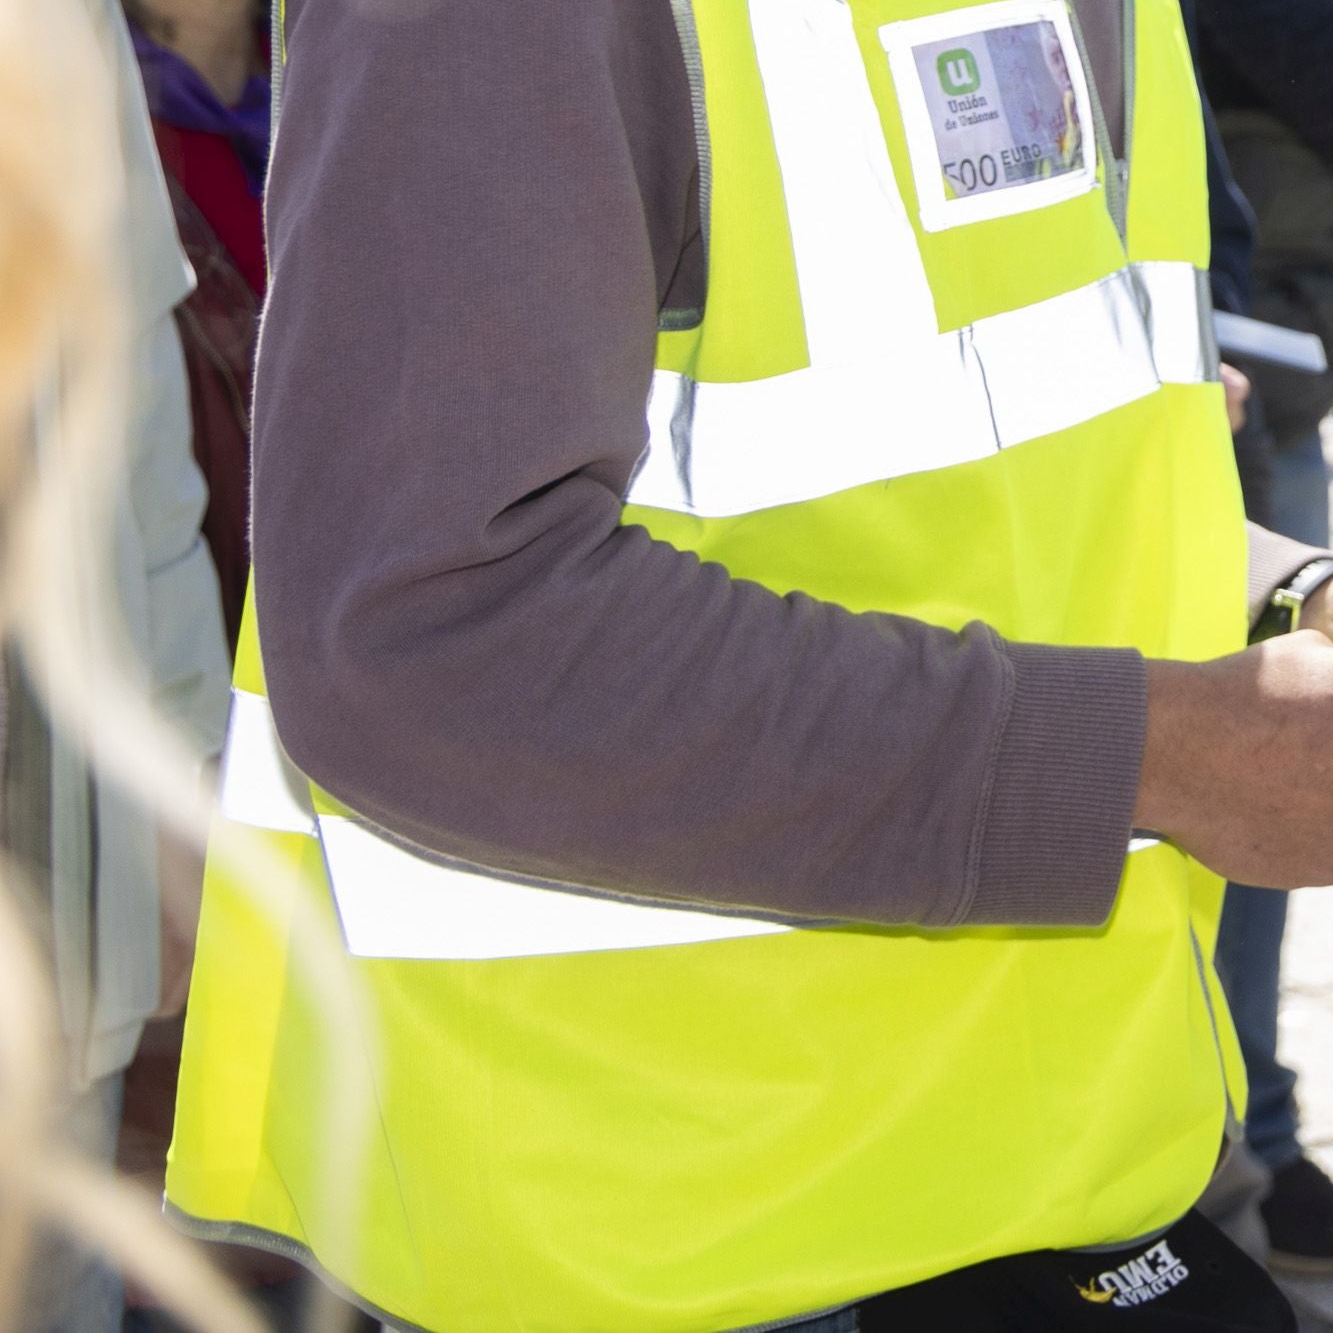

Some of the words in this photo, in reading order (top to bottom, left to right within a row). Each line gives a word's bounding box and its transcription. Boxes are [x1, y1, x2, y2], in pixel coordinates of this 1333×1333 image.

[947, 95, 988, 113] Unión
[1000, 143, 1042, 166] EURO
[1097, 1239, 1182, 1294] EMU
[1150, 1263, 1190, 1296] OLD
